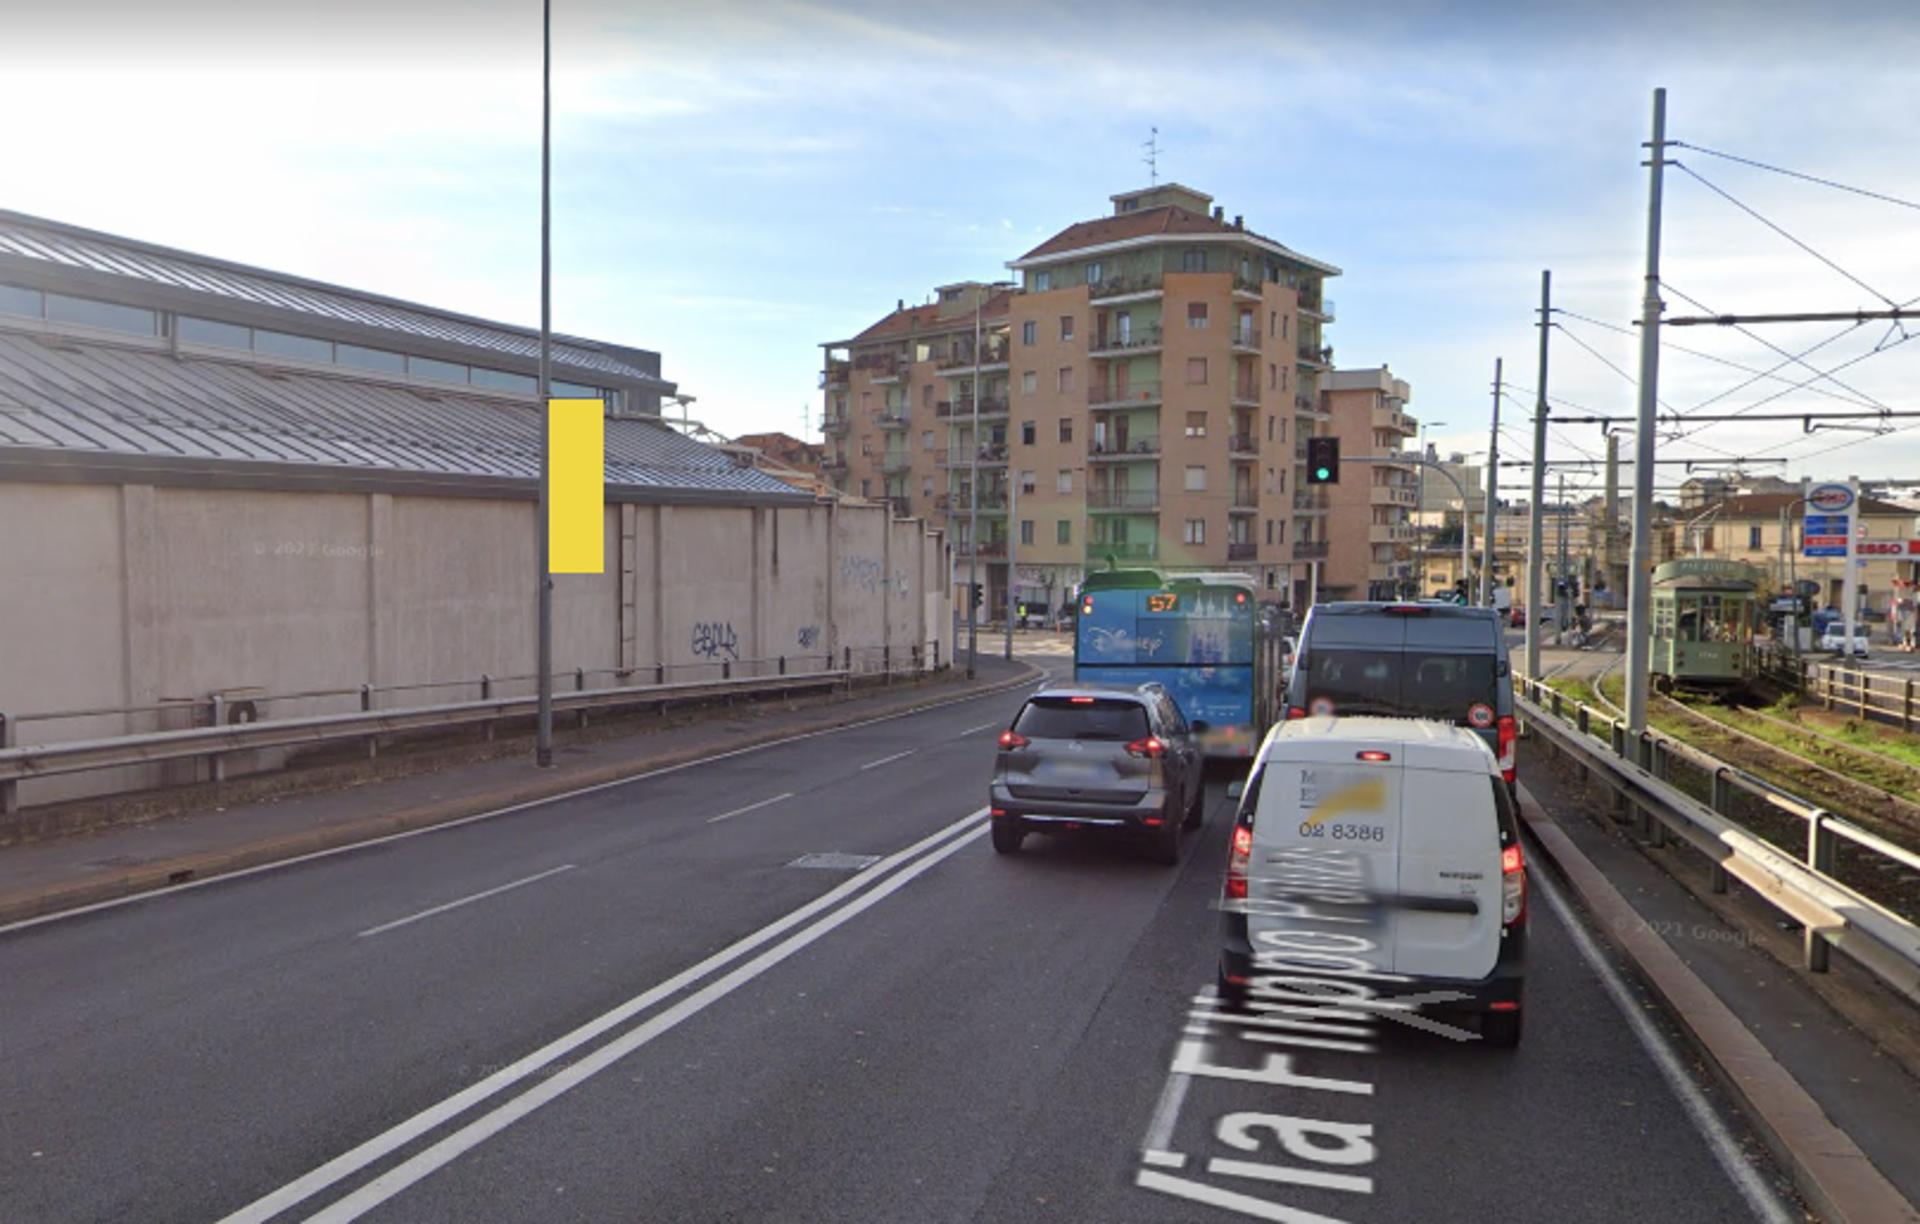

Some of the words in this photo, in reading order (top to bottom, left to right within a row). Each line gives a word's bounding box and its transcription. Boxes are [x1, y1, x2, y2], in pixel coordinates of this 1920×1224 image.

[1151, 594, 1177, 612] 57
[1088, 627, 1163, 657] Dney
[1299, 821, 1325, 838] 02
